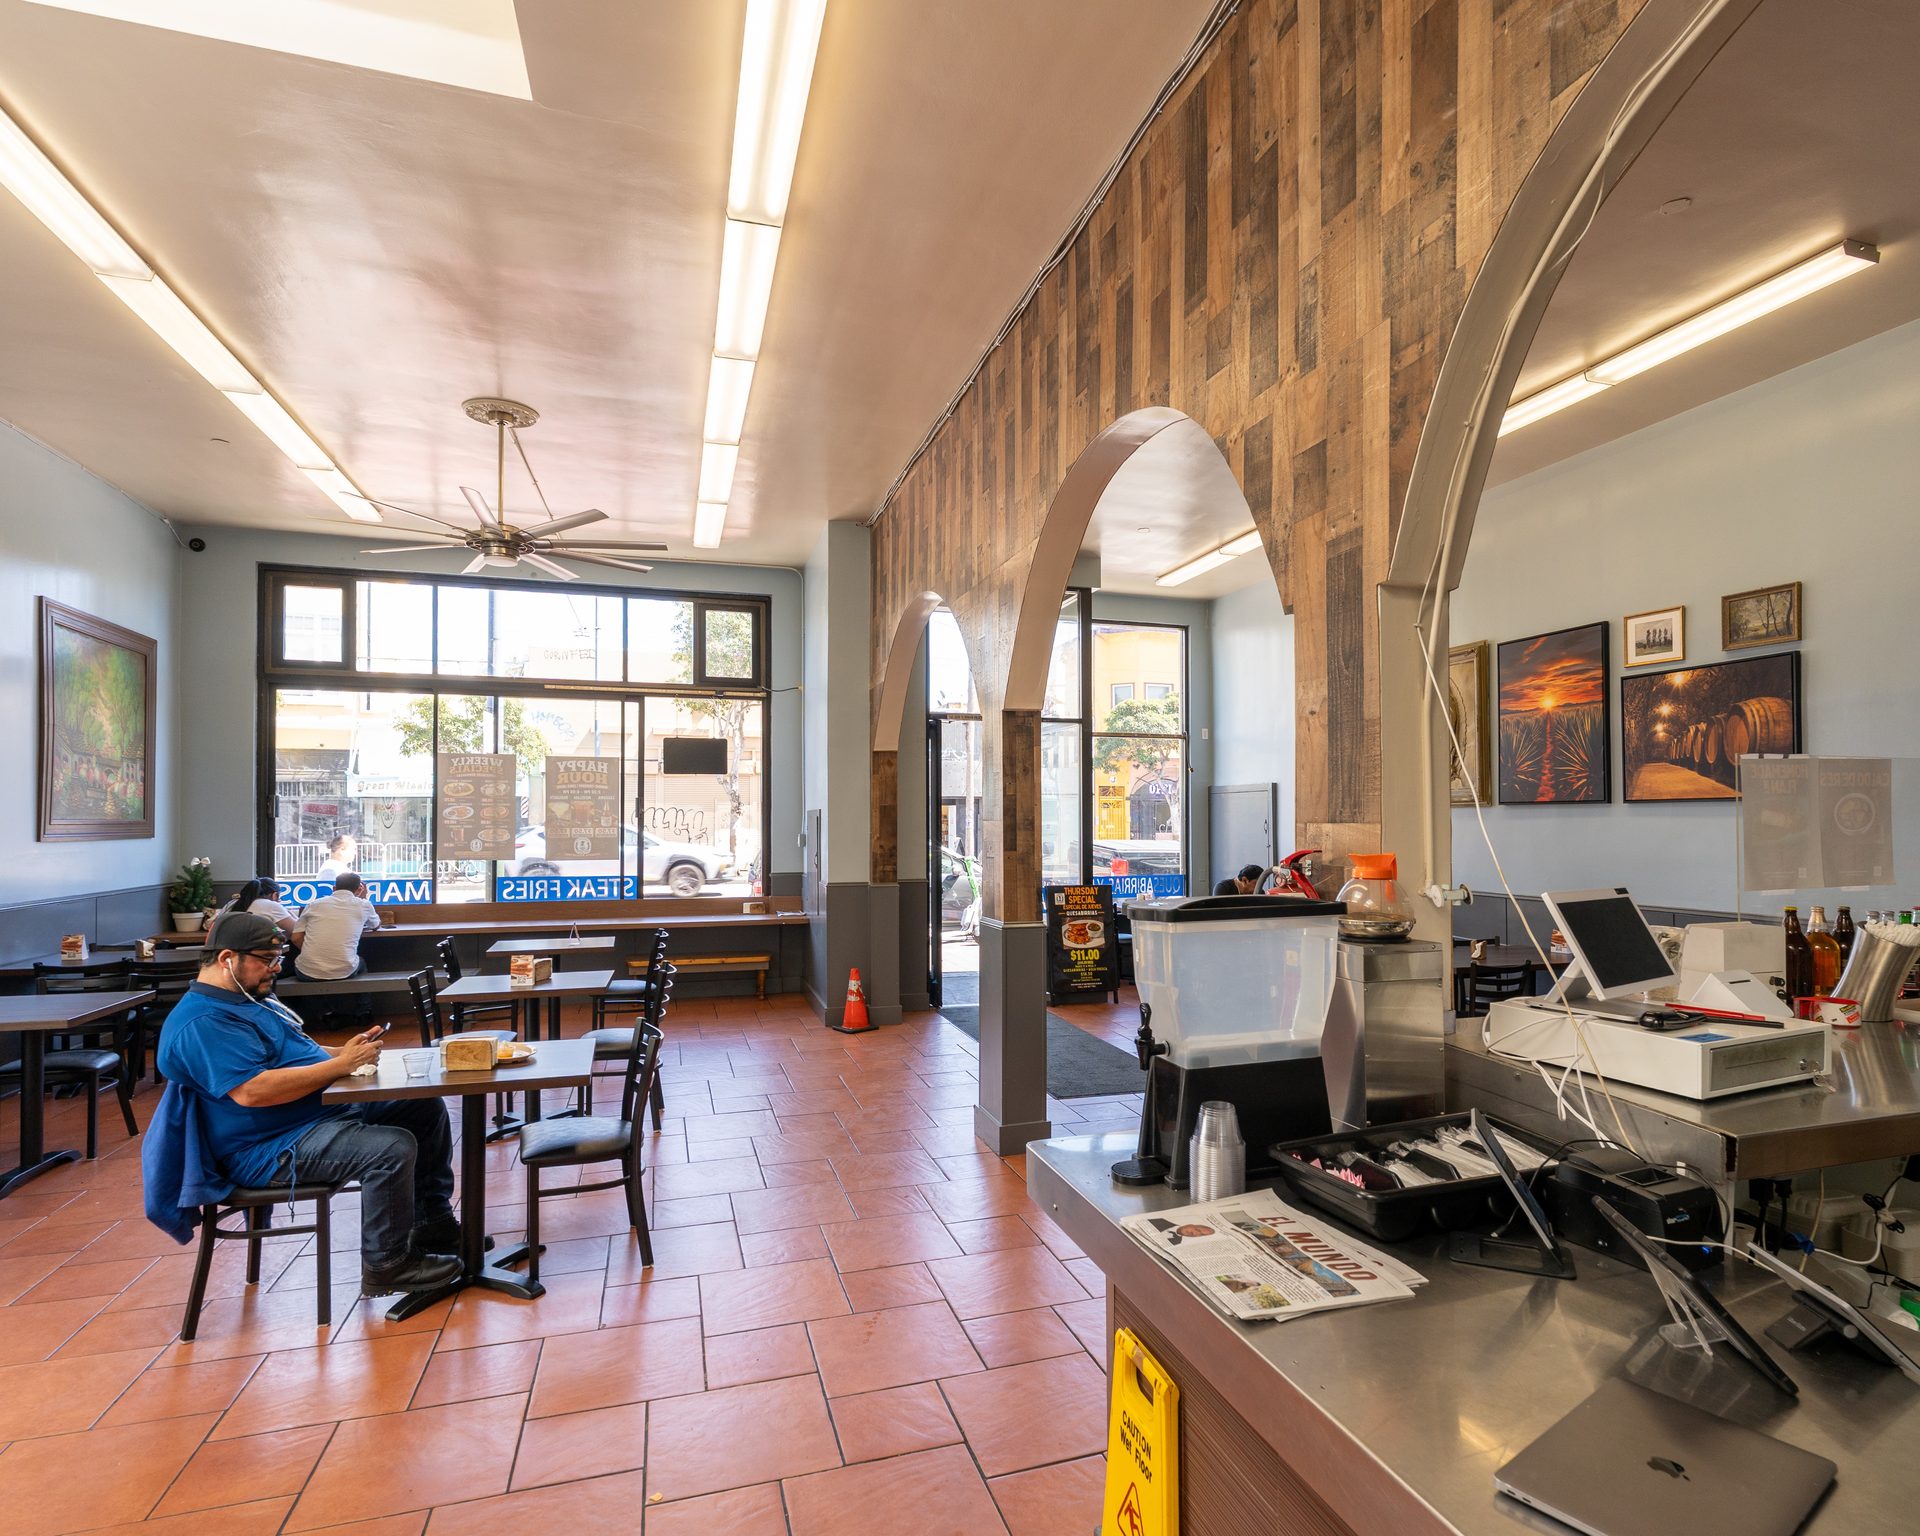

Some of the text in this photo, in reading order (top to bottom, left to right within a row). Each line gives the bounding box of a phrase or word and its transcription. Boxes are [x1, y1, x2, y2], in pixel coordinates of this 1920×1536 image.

[1063, 886, 1099, 895] THURSDAY
[1068, 895, 1097, 904] SPECIAL
[1070, 949, 1100, 961] $11.00
[1257, 1215, 1297, 1228] EL
[1283, 1231, 1378, 1281] MUNDO
[1122, 1410, 1152, 1461] CAUTION
[1120, 1426, 1152, 1483] Wet Floor
